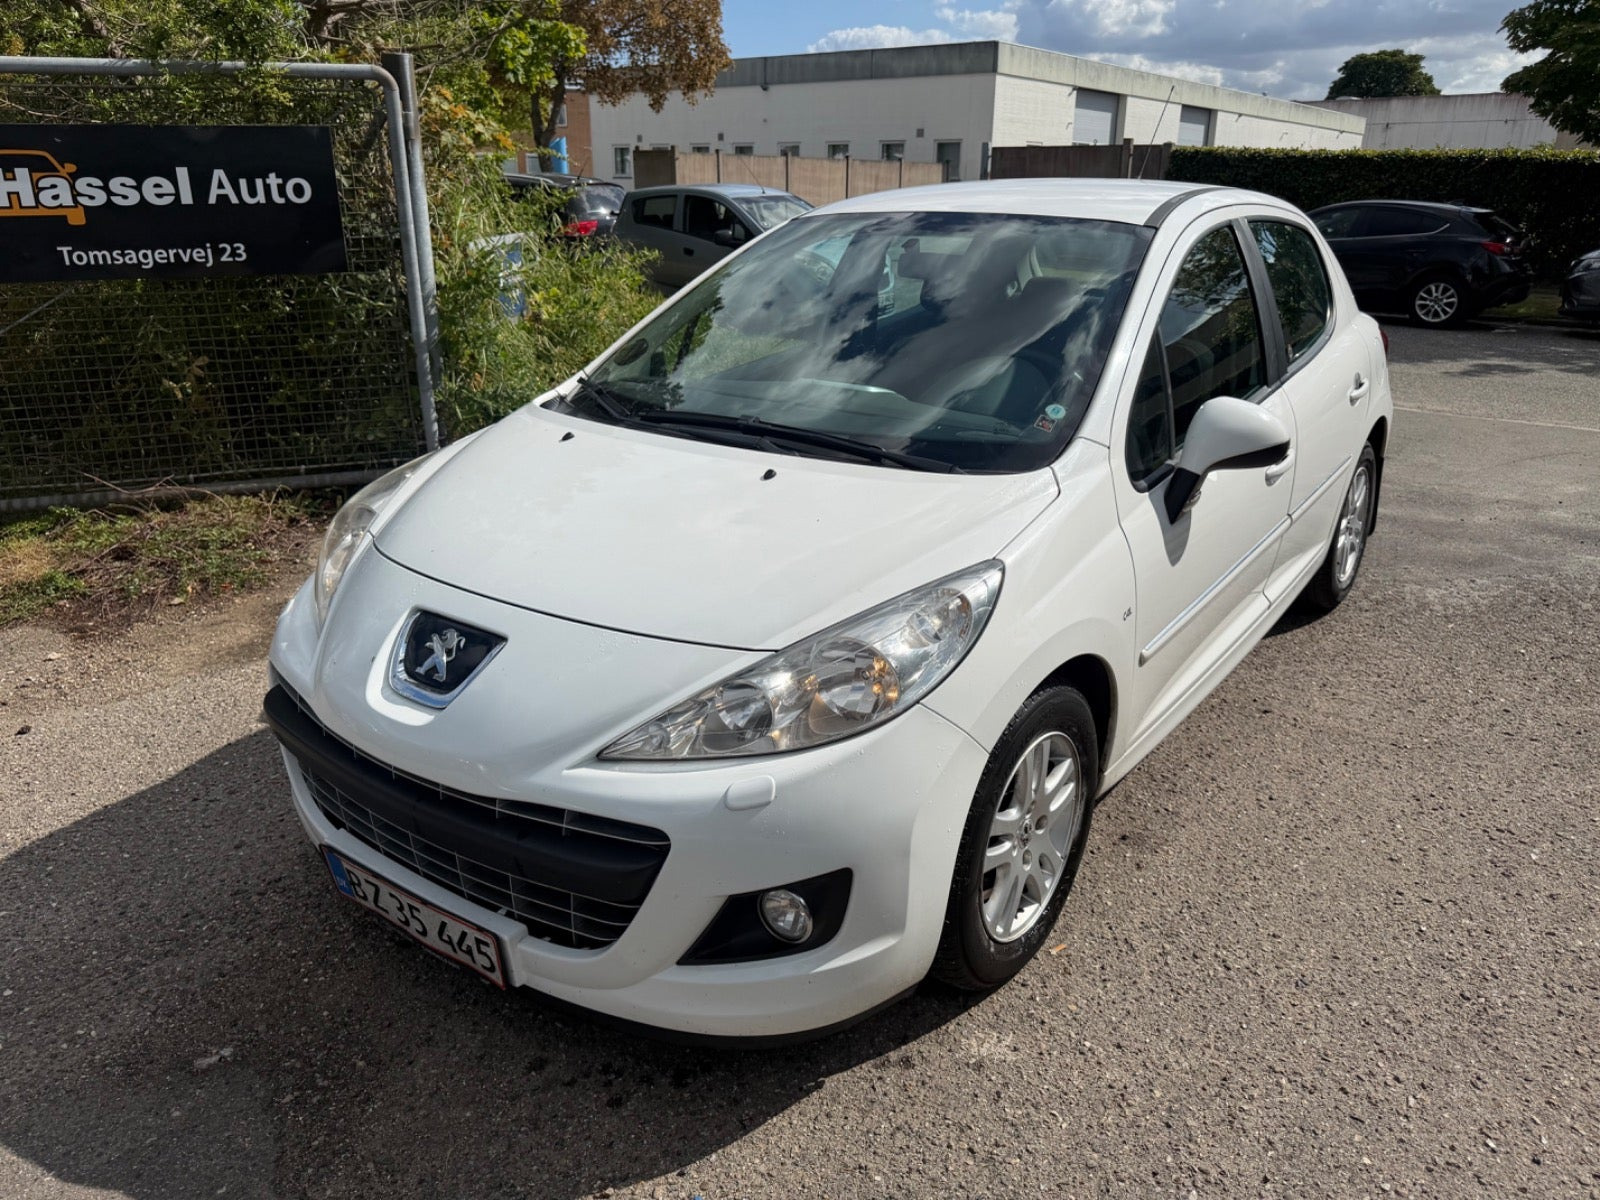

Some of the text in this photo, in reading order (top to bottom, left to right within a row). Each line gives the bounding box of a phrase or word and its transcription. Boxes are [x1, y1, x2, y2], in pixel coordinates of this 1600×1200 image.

[0, 166, 312, 207] Hassel Auto
[56, 243, 247, 269] Tomsagervej 23
[345, 867, 496, 973] BZ 35 445
